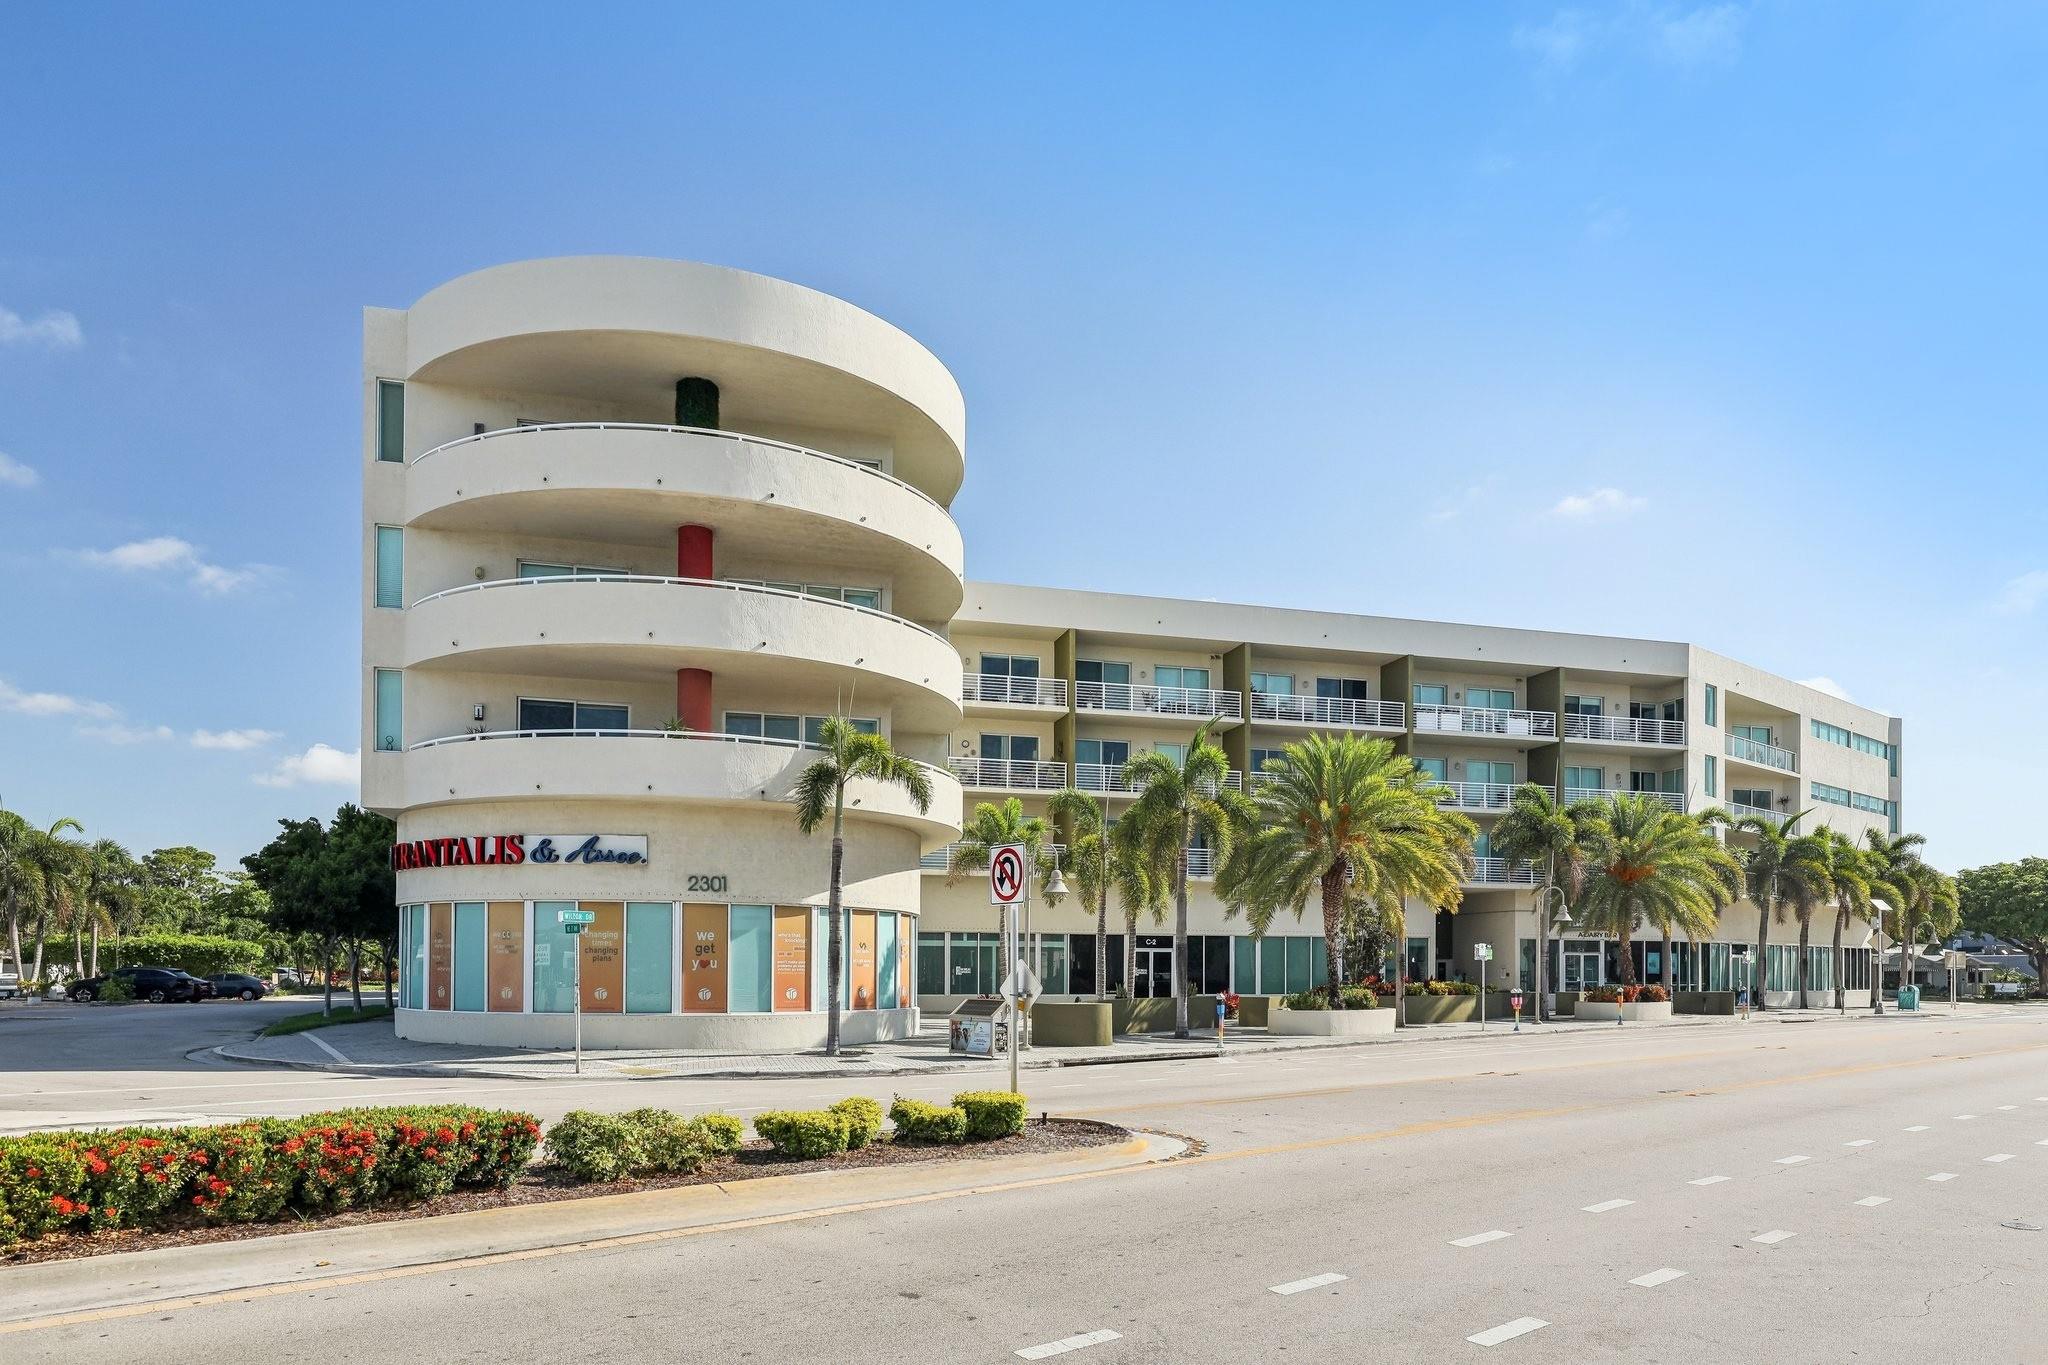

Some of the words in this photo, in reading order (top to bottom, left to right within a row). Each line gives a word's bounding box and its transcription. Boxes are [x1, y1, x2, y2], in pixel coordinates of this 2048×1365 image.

[530, 839, 560, 863] &
[687, 875, 728, 892] 2301
[696, 931, 715, 941] we
[584, 946, 618, 956] changing
[695, 943, 716, 956] get
[592, 954, 612, 963] plans
